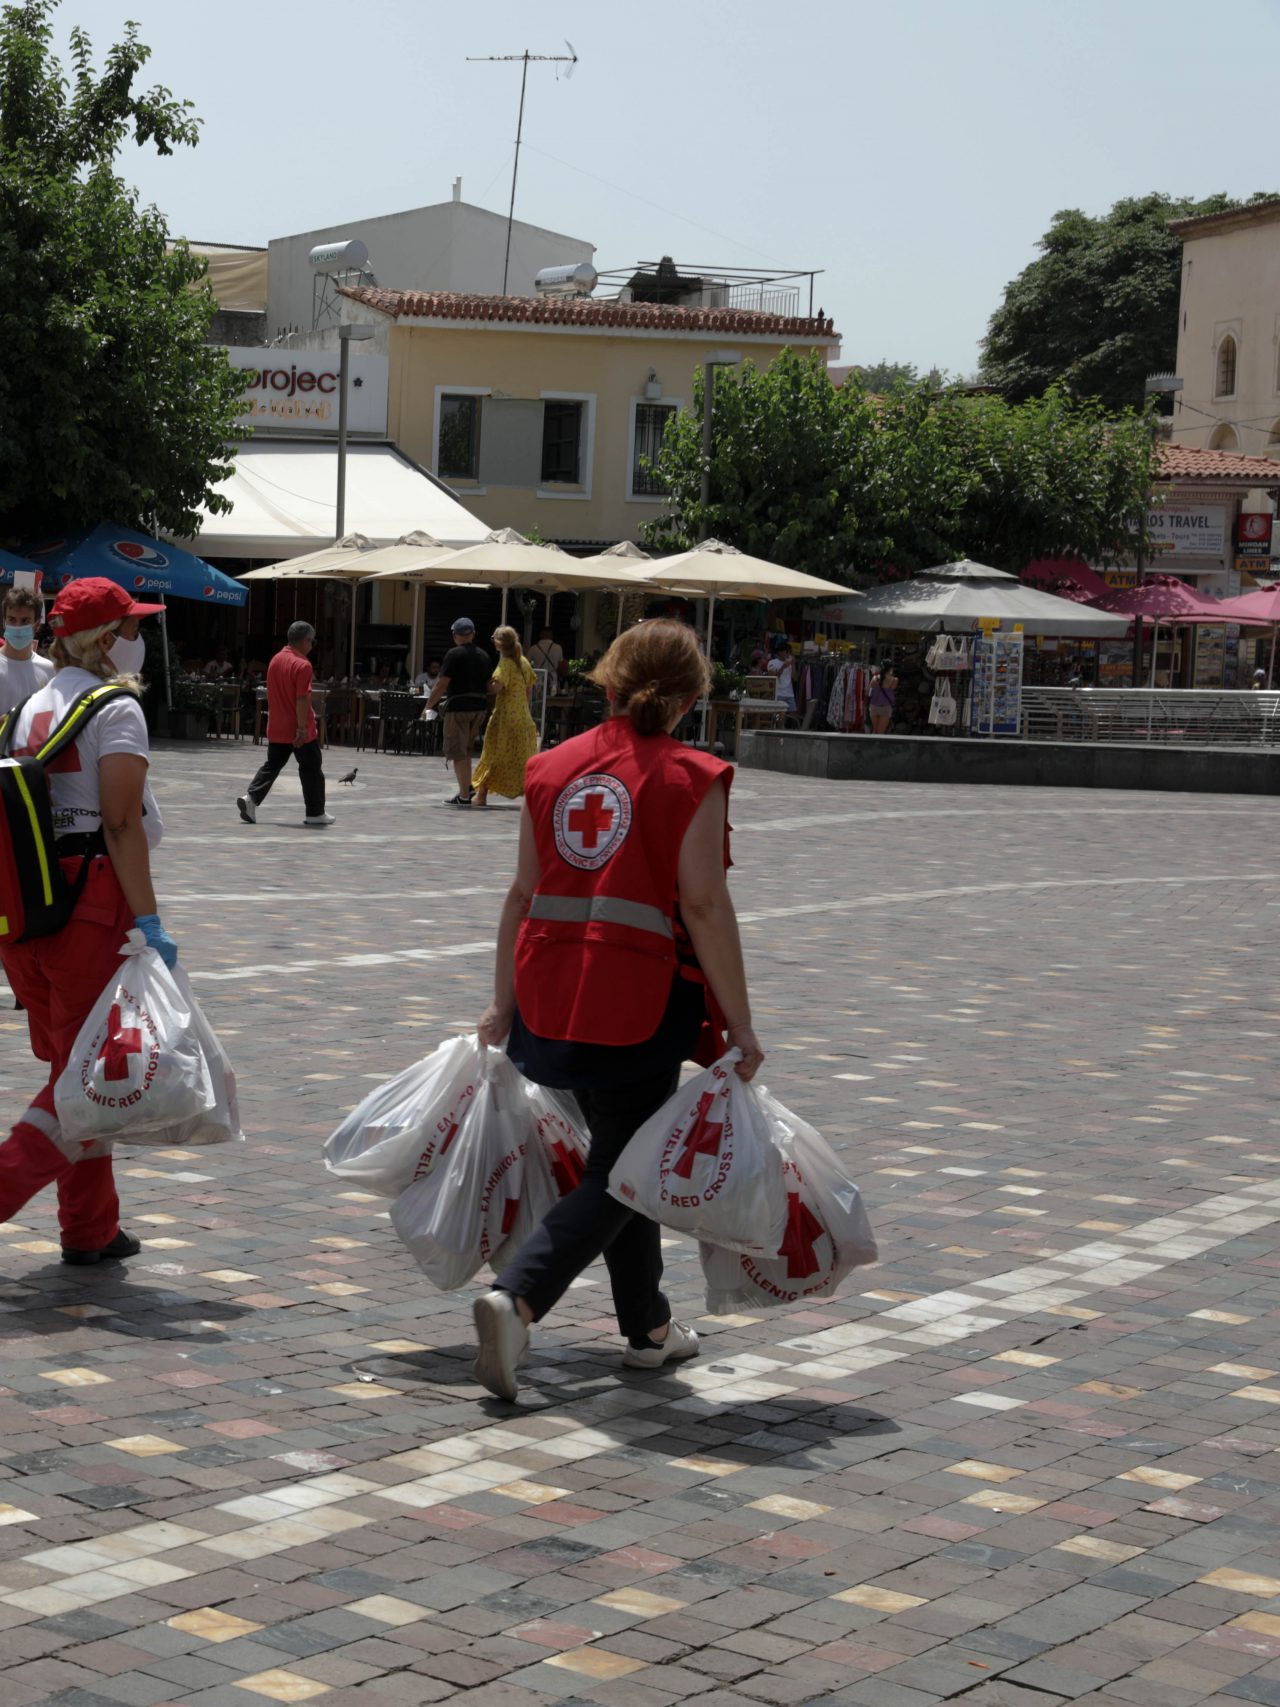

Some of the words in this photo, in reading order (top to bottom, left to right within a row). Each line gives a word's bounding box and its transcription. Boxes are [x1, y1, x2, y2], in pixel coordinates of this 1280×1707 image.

[242, 364, 341, 397] projec
[1169, 515, 1210, 528] TRAVEL
[1240, 560, 1266, 568] ATM
[147, 578, 172, 590] pepsi
[1110, 575, 1136, 586] ATM
[217, 589, 242, 601] pepsi
[118, 1088, 142, 1109] RED
[143, 1042, 161, 1091] CROSS
[671, 1193, 701, 1209] RED
[703, 1151, 734, 1202] CROSS
